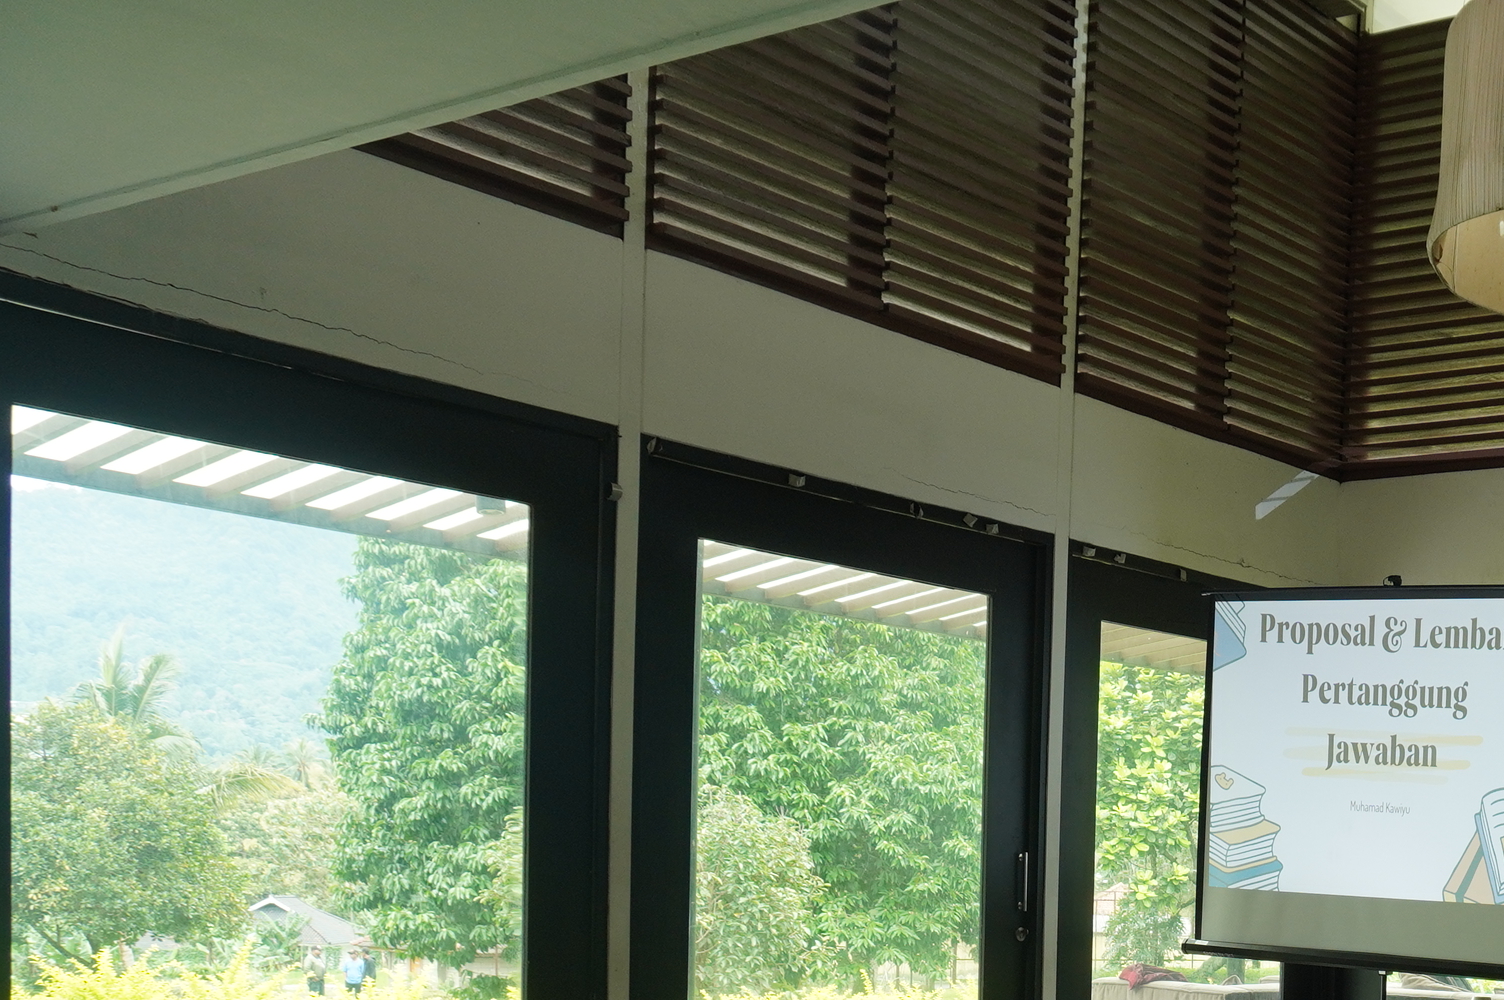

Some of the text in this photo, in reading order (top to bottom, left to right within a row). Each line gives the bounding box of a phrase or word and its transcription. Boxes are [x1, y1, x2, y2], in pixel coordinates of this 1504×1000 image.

[1259, 613, 1376, 654] Proposal
[1382, 616, 1407, 653] &
[1301, 673, 1469, 720] Pertanggung
[1325, 733, 1438, 771] Jawaban
[1350, 801, 1384, 814] Muhamad
